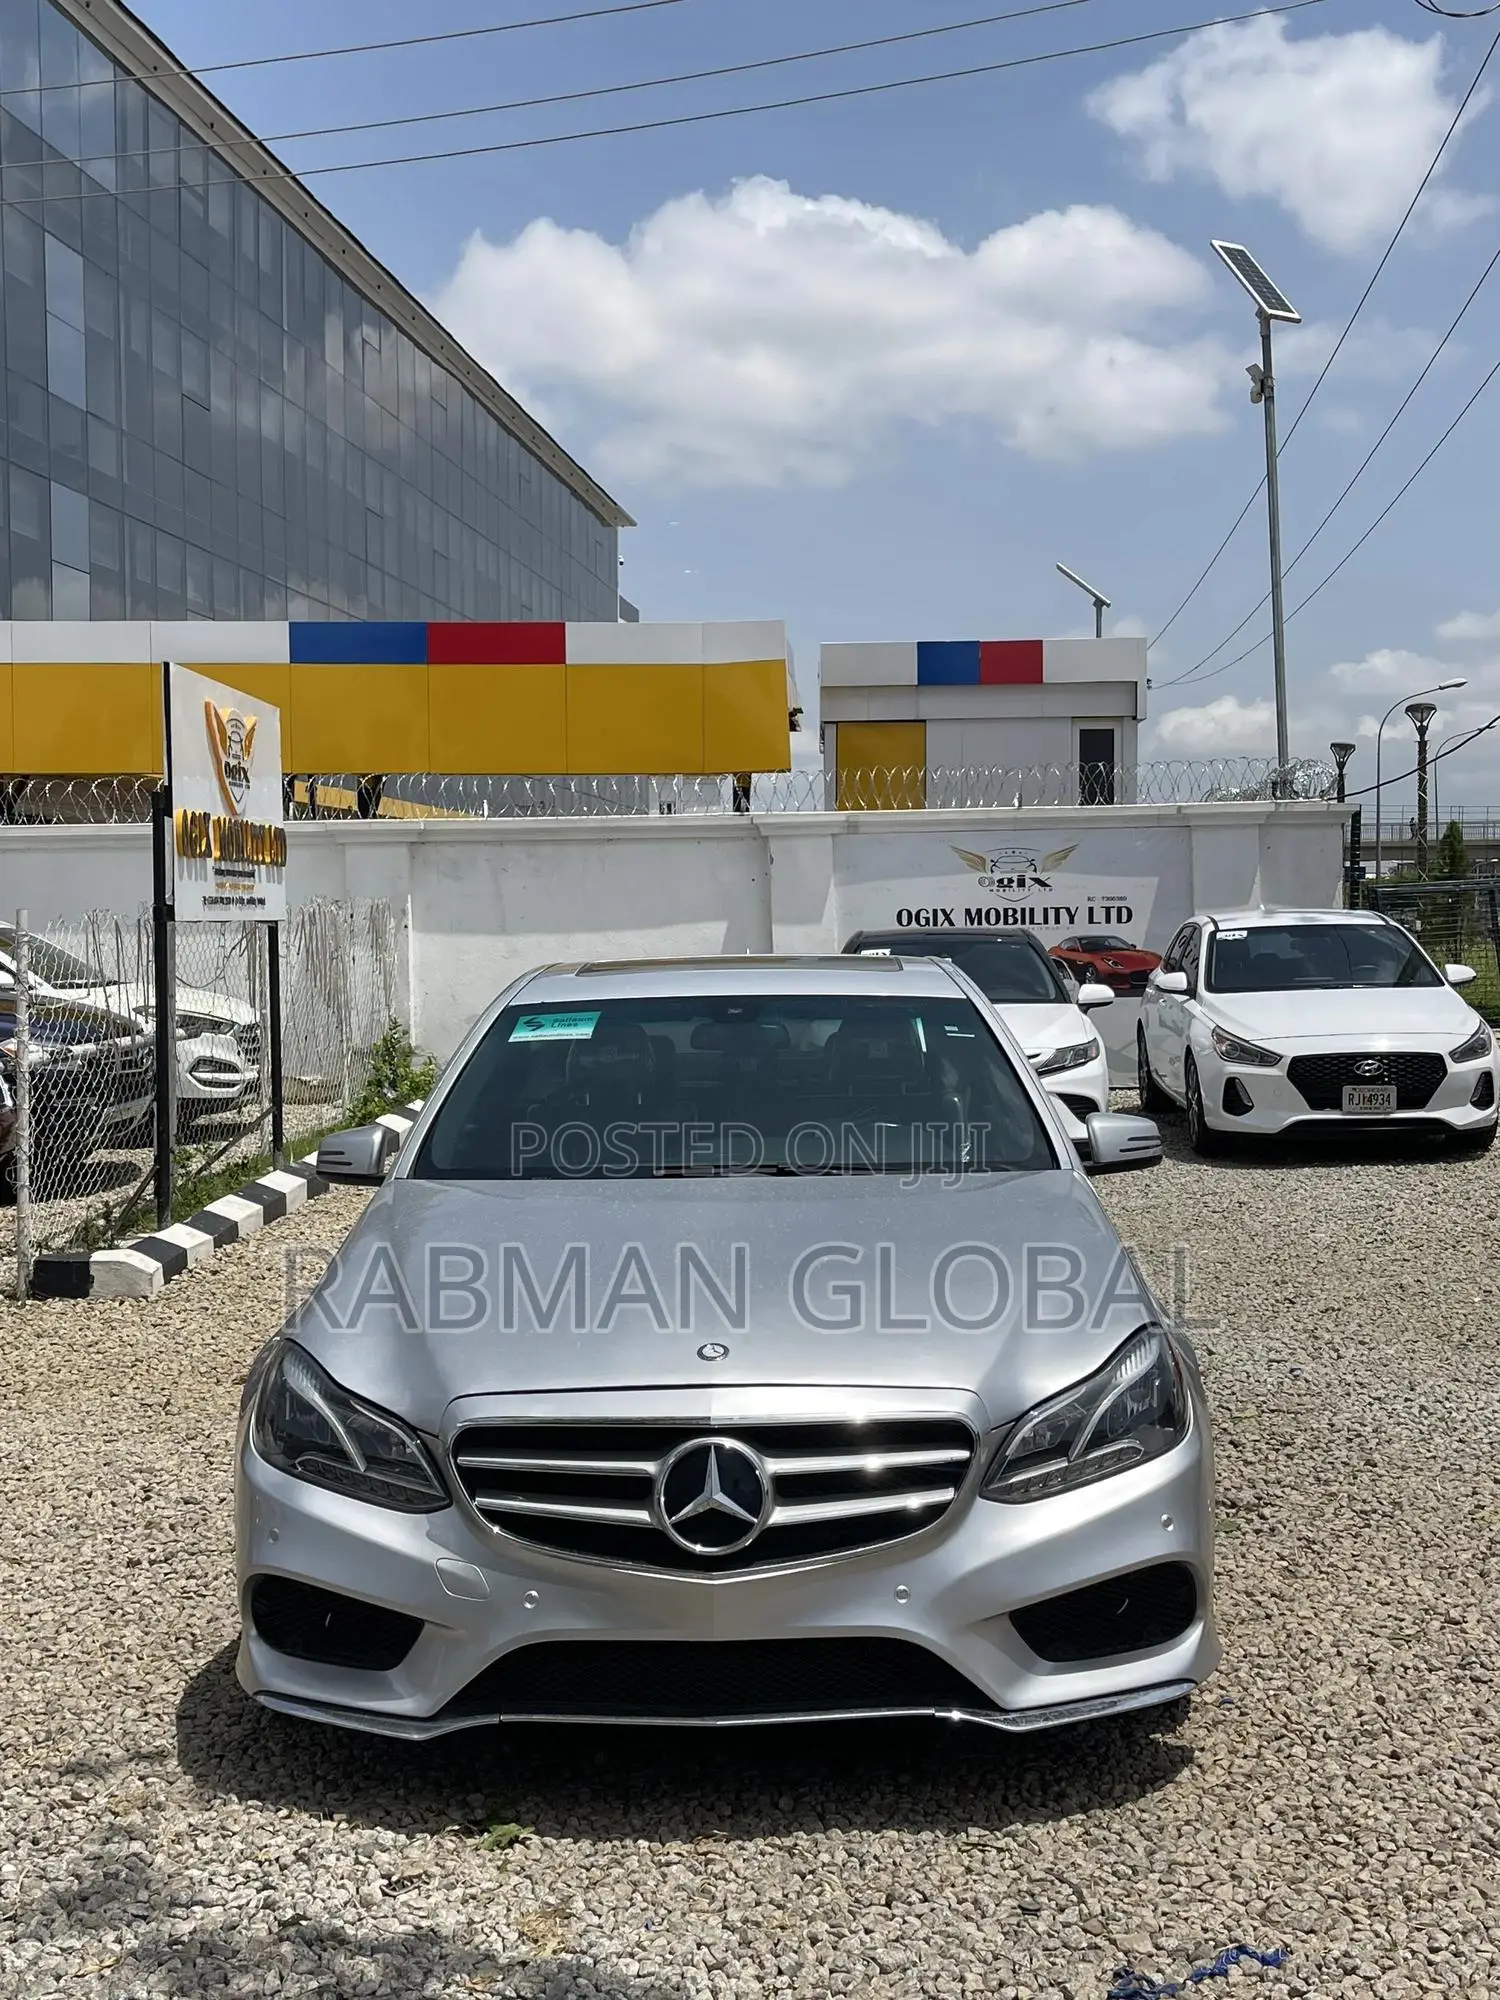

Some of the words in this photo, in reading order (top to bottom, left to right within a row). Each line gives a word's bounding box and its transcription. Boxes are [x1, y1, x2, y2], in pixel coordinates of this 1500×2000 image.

[896, 908, 956, 927] OGIX
[964, 906, 1079, 926] MOBILITY
[1087, 905, 1133, 924] LTD
